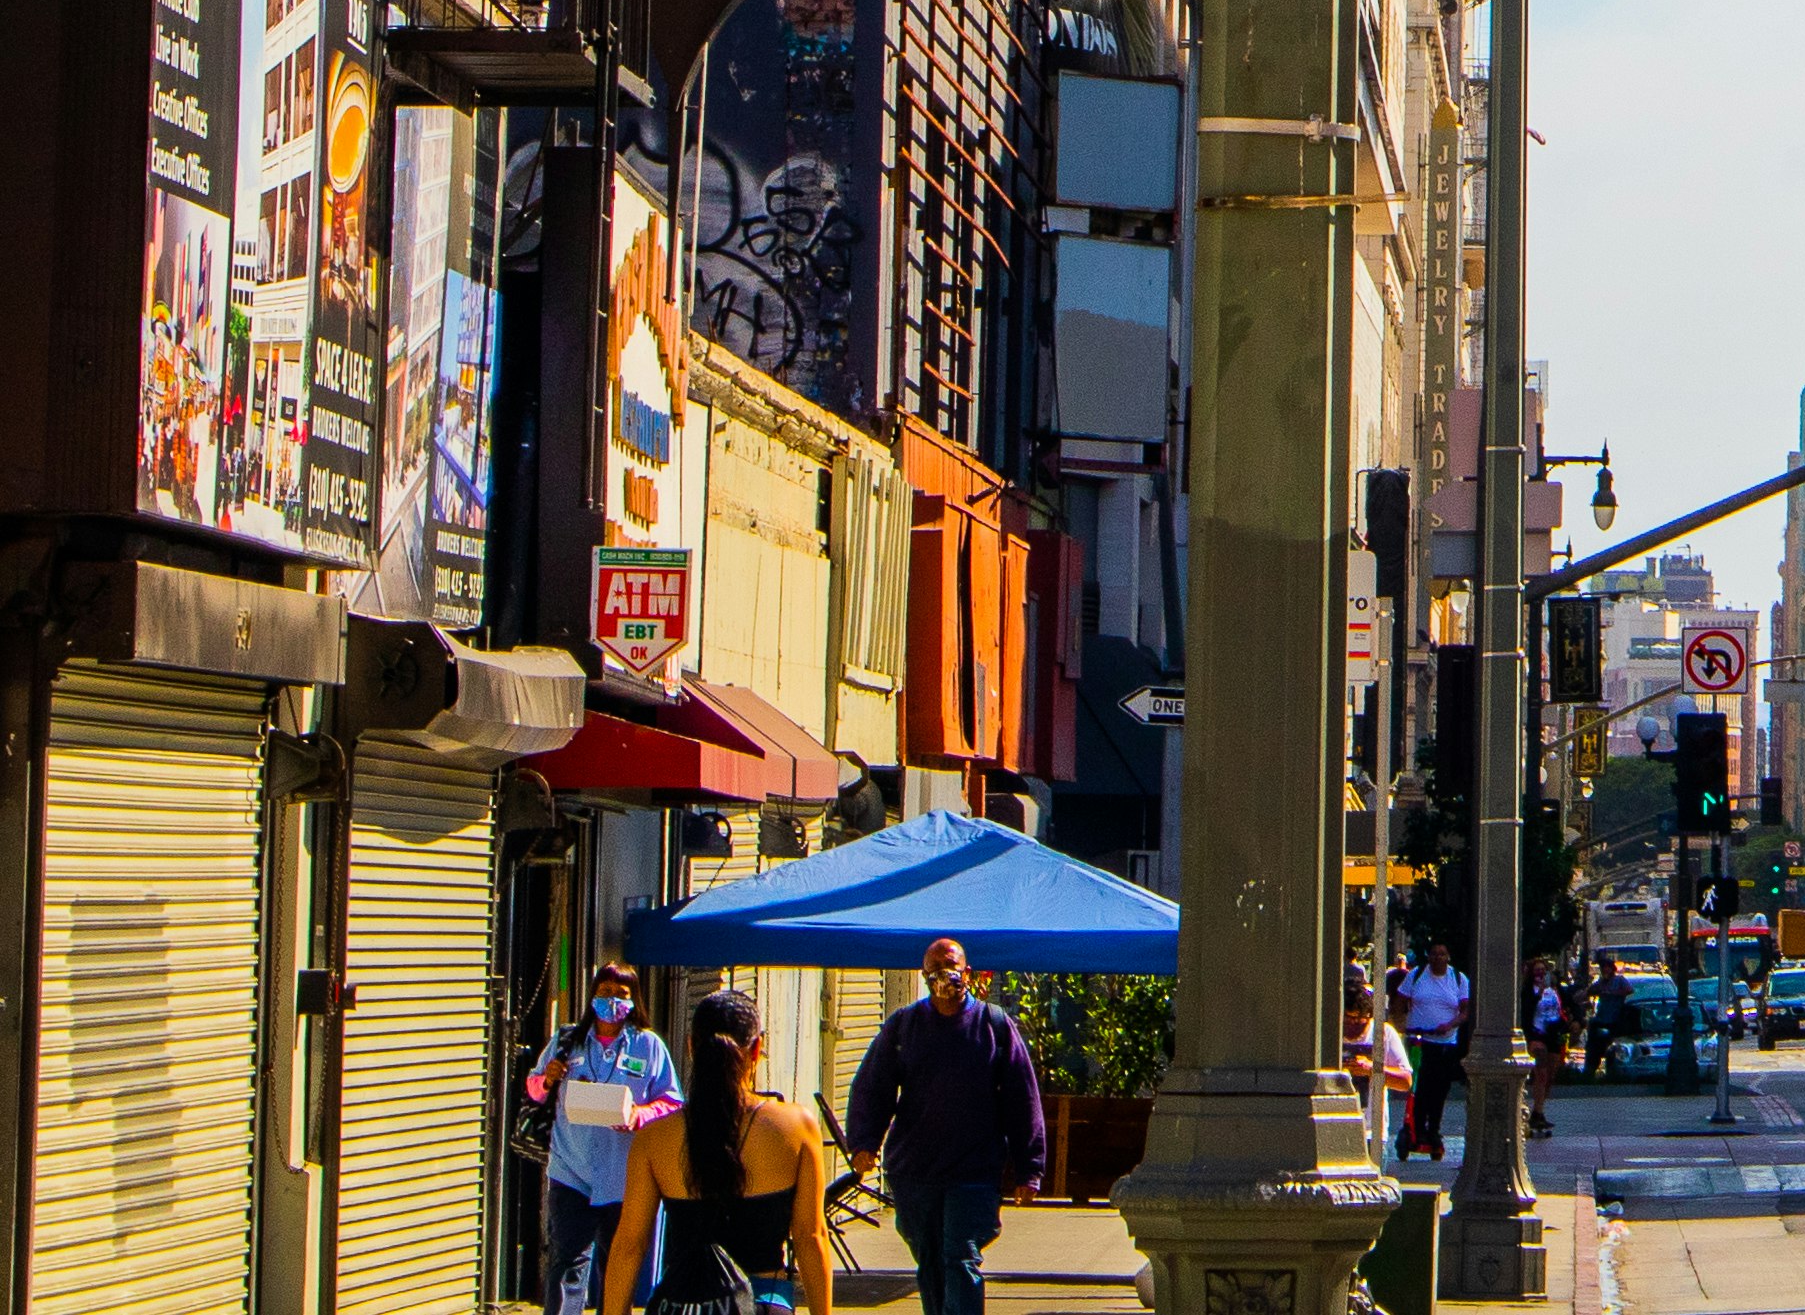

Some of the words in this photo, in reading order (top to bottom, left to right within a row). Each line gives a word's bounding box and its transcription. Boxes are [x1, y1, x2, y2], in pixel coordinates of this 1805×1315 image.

[156, 23, 172, 65] Live
[179, 36, 199, 79] Work
[153, 80, 183, 127] Creative
[183, 95, 208, 139] Offices
[151, 137, 185, 182] Executive
[185, 152, 210, 195] Offices
[1432, 144, 1450, 336] JEWELRY
[315, 337, 342, 392] SPACE
[341, 348, 349, 395] 4
[604, 572, 681, 616] ATM
[624, 624, 658, 640] EBT
[630, 646, 648, 660] OK
[1152, 699, 1184, 713] ONE
